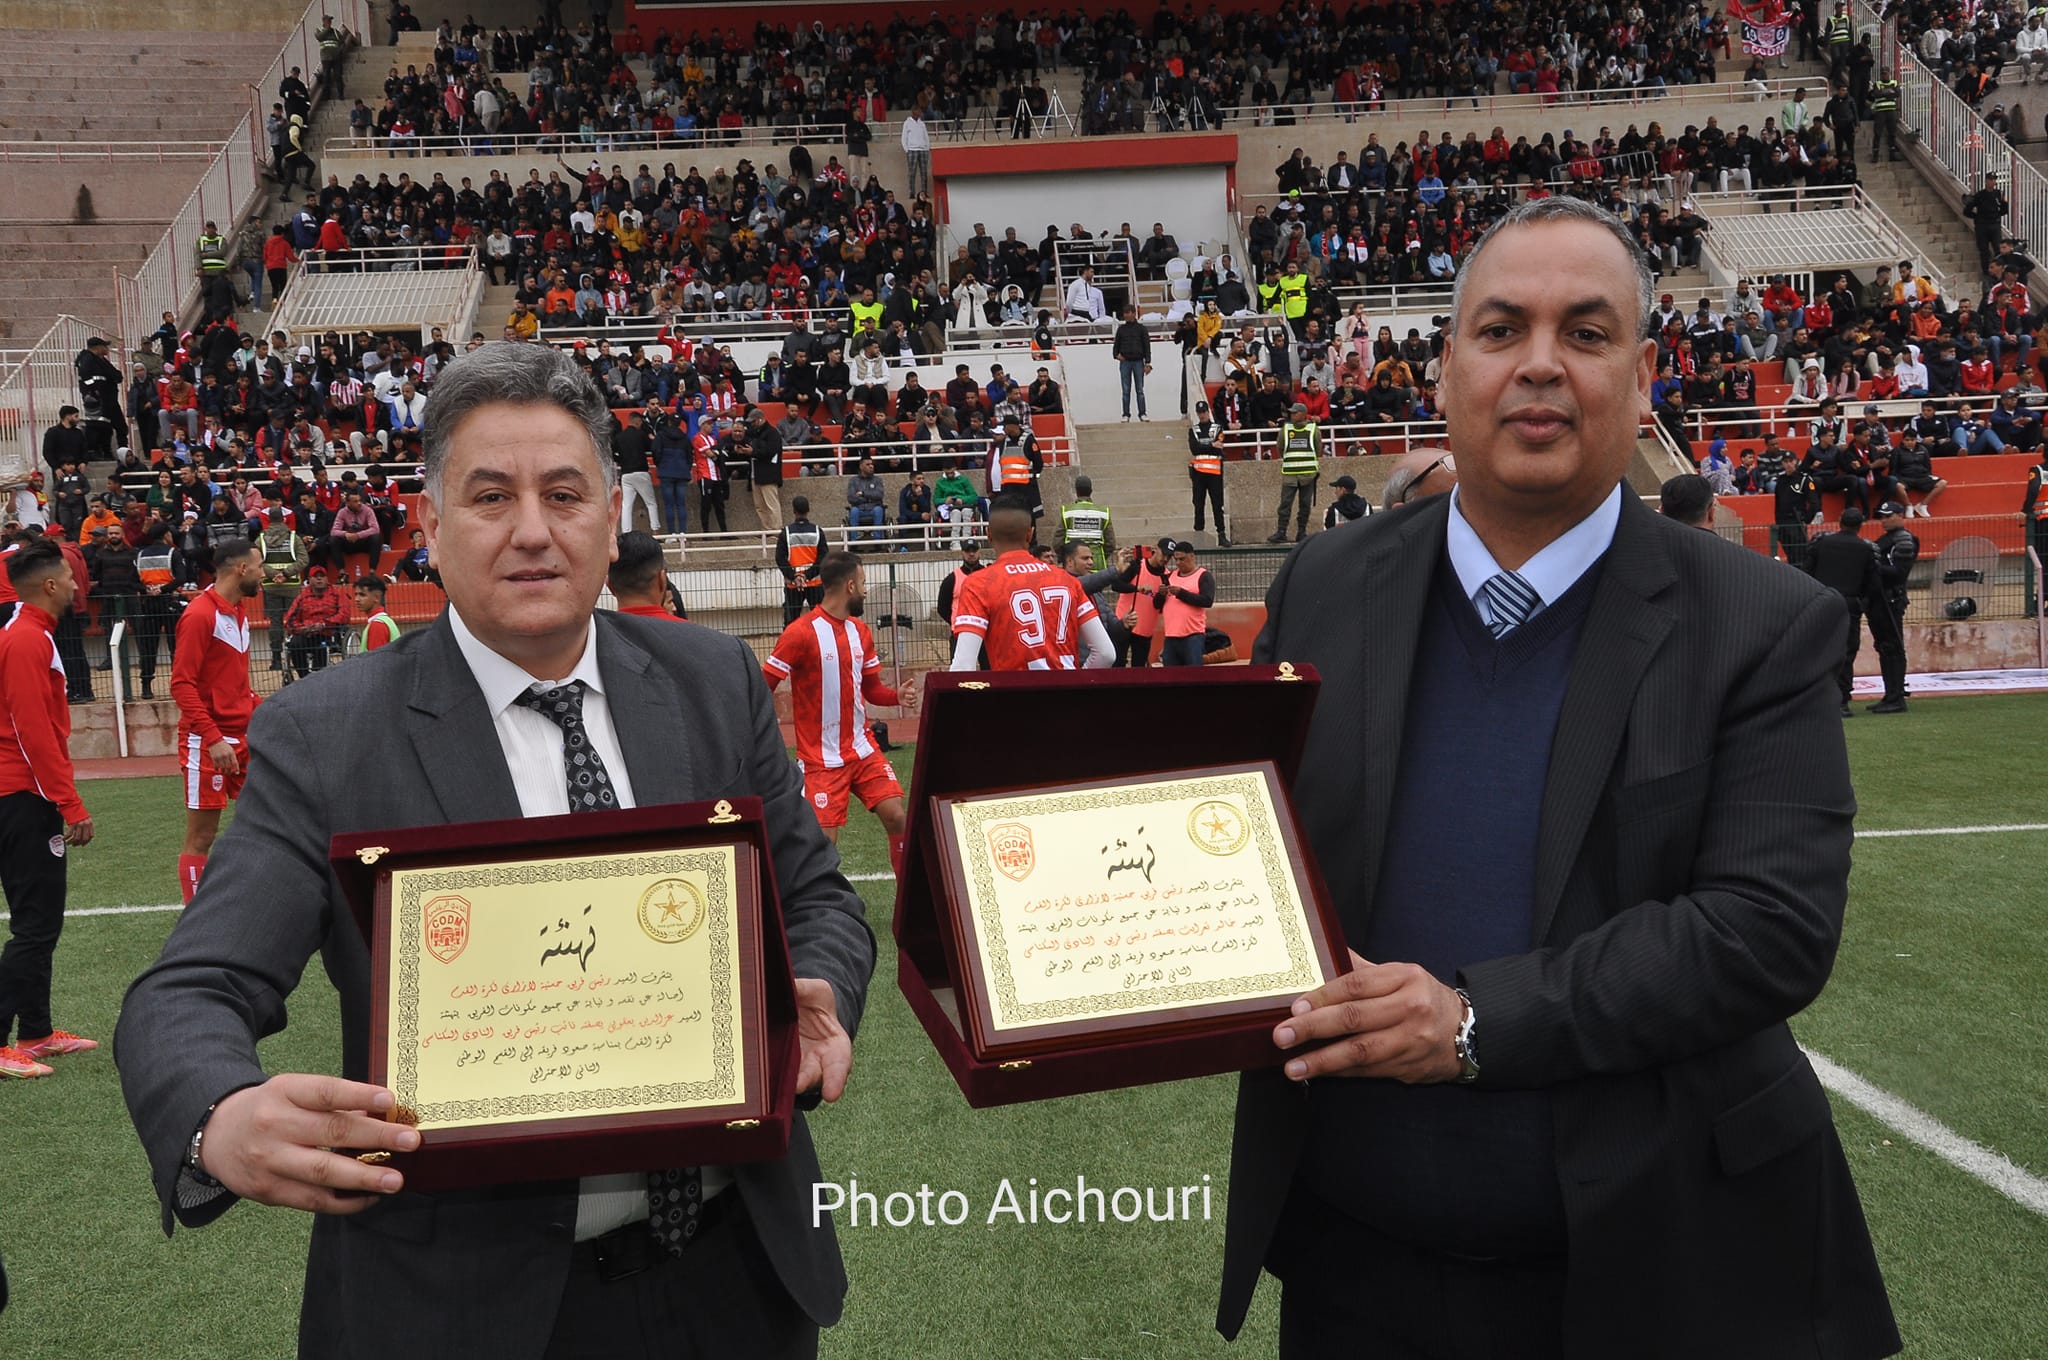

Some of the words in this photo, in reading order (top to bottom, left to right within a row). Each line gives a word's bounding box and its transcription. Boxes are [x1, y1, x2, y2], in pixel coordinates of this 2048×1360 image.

[1005, 562, 1051, 575] CODM
[1009, 585, 1072, 649] 97
[998, 840, 1026, 851] CODM
[1101, 826, 1155, 884] تهنئة
[1141, 887, 1157, 901] فريق
[1162, 884, 1182, 899] رئيس
[1187, 881, 1209, 893] السيد
[1024, 899, 1051, 912] القدم
[1055, 894, 1070, 911] لكرة
[1216, 901, 1228, 911] عن
[1120, 912, 1139, 923] جميع
[1145, 909, 1157, 920] عن
[1162, 906, 1180, 915] نيابة
[432, 915, 462, 928] CODM
[1046, 917, 1072, 932] الفريق
[1076, 909, 1114, 927] مكونات
[1215, 919, 1236, 931] خالد
[1241, 915, 1264, 928] السيد
[540, 904, 596, 973] تهنئة
[1104, 932, 1121, 947] فريق
[1126, 929, 1147, 945] رئيس
[1242, 934, 1258, 951] لكرة
[1179, 945, 1209, 955] بمناسبة
[1212, 939, 1238, 953] القدم
[1125, 951, 1144, 965] فريقه
[1149, 949, 1175, 961] صعود
[1082, 955, 1104, 973] القسم
[568, 977, 585, 991] فريق
[589, 974, 612, 990] رئيس
[613, 972, 637, 985] السيد
[450, 984, 478, 998] القدم
[481, 980, 498, 998] لكرة
[498, 1000, 536, 1015] مكونات
[540, 1002, 562, 1013] جميع
[567, 1000, 580, 1011] عن
[585, 998, 602, 1008] نيابة
[639, 995, 653, 1006] عن
[468, 1004, 494, 1020] الفريق
[677, 1010, 702, 1023] السيد
[502, 1025, 520, 1039] فريق
[524, 1022, 546, 1038] رئيس
[550, 1020, 576, 1035] نائب
[592, 1040, 622, 1050] بمناسبة
[625, 1035, 652, 1050] القدم
[655, 1032, 672, 1049] لكرة
[493, 1047, 516, 1065] القسم
[537, 1044, 557, 1058] فريقه
[561, 1043, 588, 1056] صعود
